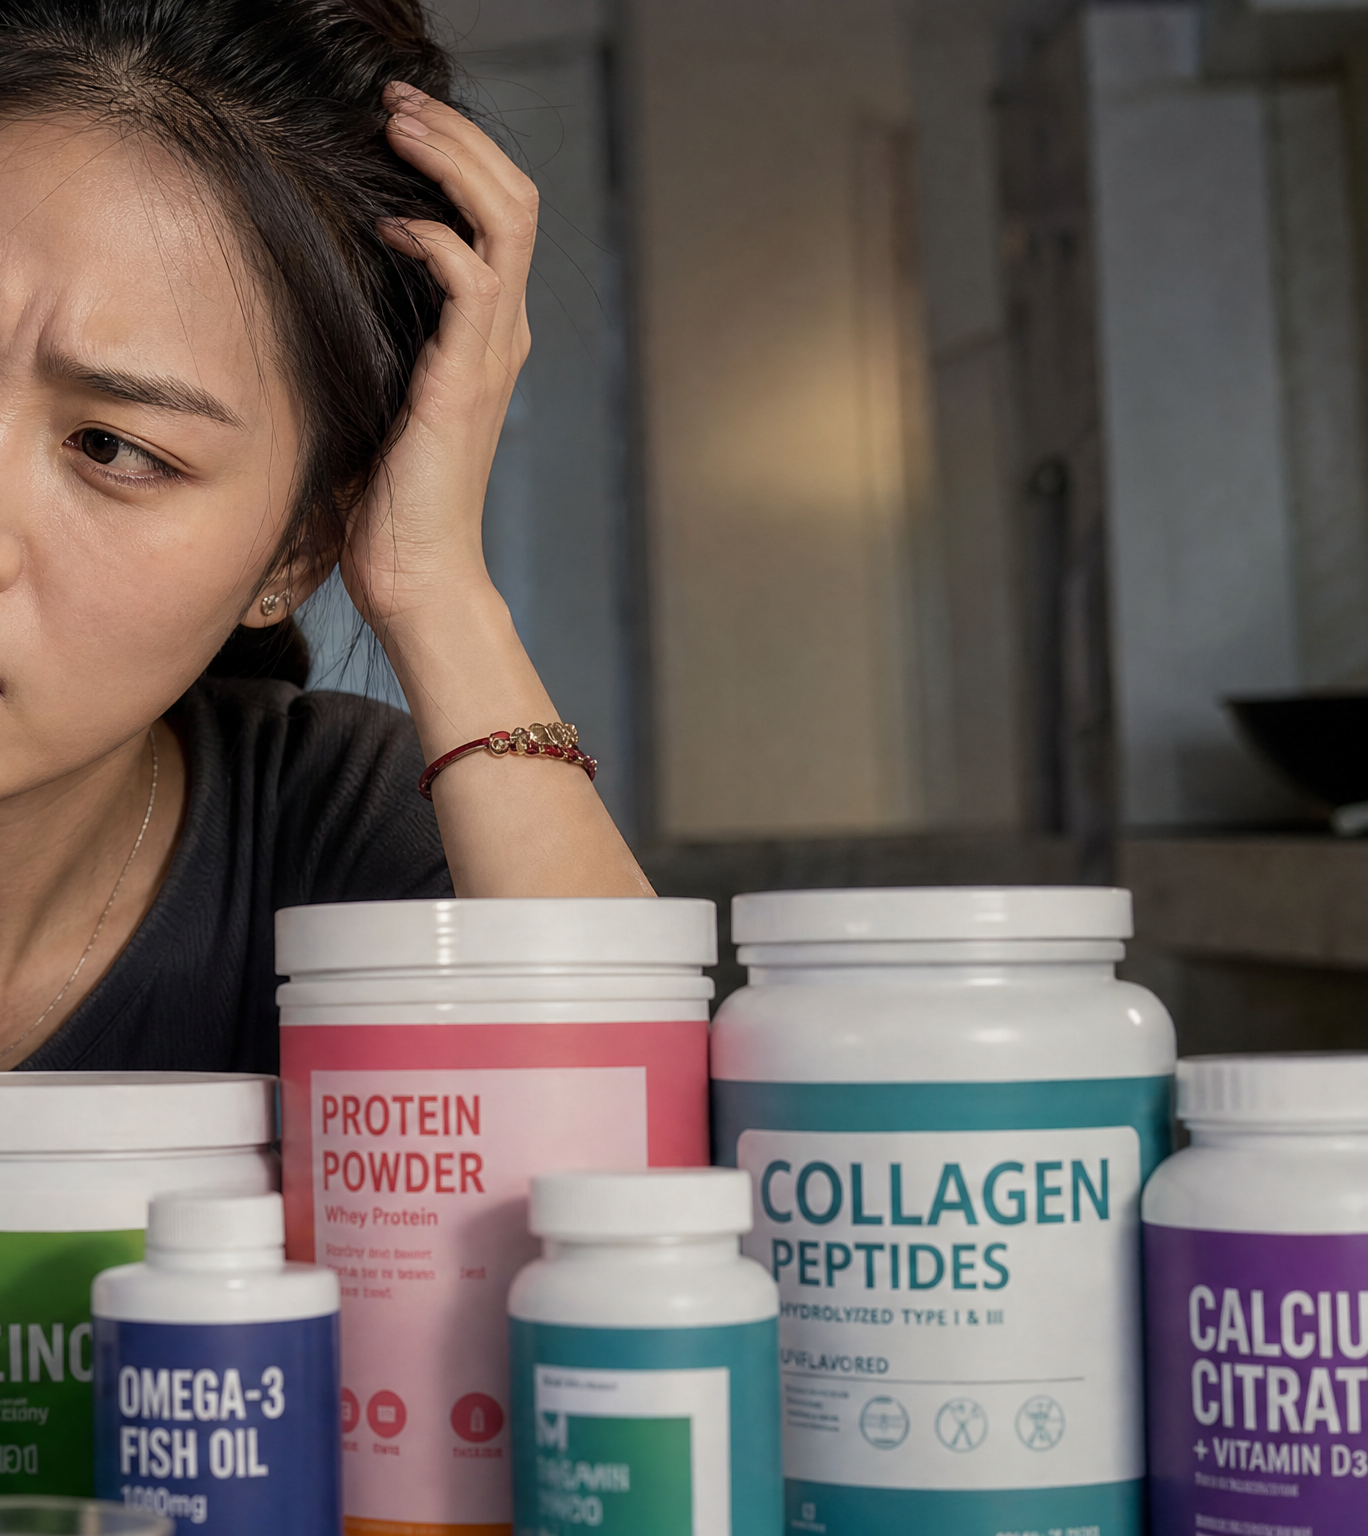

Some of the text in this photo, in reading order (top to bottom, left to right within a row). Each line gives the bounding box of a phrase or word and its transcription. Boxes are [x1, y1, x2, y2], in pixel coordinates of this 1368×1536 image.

[322, 1095, 481, 1136] PROTEIN
[323, 1151, 485, 1194] POWDER
[761, 1158, 1110, 1226] COLLAGEN
[325, 1206, 438, 1227] Whey Protein
[772, 1239, 1010, 1290] PEPTIDES
[901, 1309, 948, 1326] TYPE
[967, 1310, 979, 1326] &
[1188, 1284, 1368, 1360] CALCIU
[118, 1365, 285, 1421] OMEGA-3
[120, 1426, 268, 1479] FISH OIL
[1193, 1437, 1368, 1478] + VITAMIN D3
